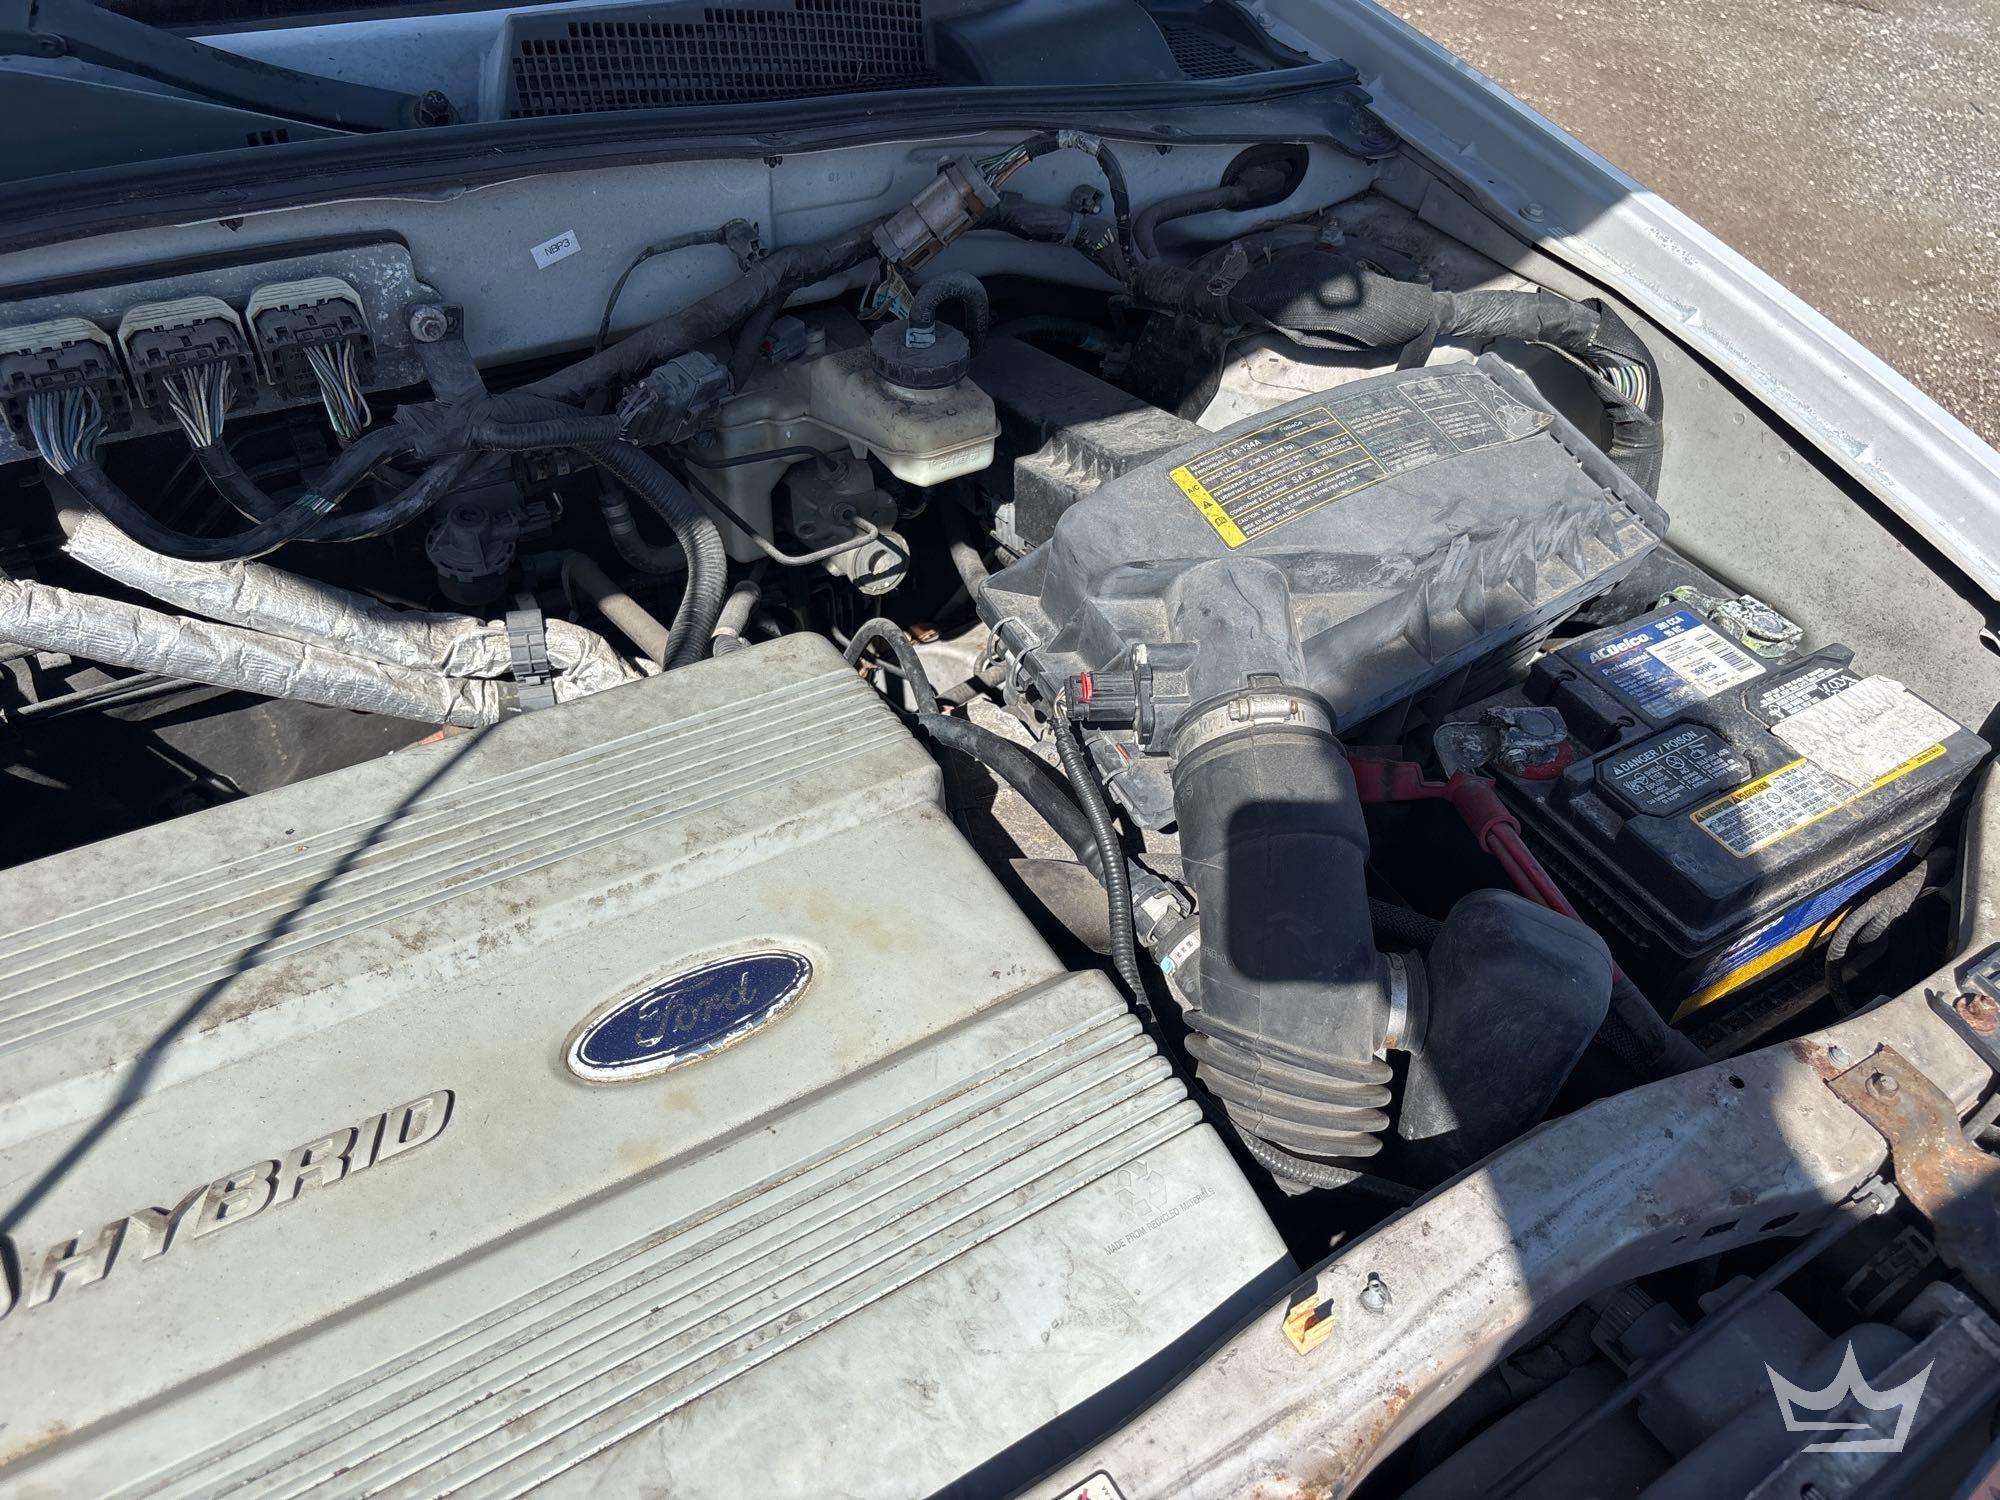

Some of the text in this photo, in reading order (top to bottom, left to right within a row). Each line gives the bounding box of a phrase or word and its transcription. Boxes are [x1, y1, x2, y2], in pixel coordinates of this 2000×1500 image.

[1231, 439, 1262, 456] R-134A
[1187, 485, 1200, 494] A/C
[1290, 472, 1311, 484] SAE
[1590, 633, 1651, 664] ACDelco
[1602, 652, 1650, 676] Professional
[1620, 749, 1660, 772] DANGER
[1664, 731, 1699, 751] POISON
[634, 971, 757, 1048] Ford
[28, 1089, 456, 1308] HYBRID
[1104, 1240, 1126, 1256] MADE
[1125, 1225, 1147, 1245] FROM
[1146, 1207, 1180, 1231] RECYCLED
